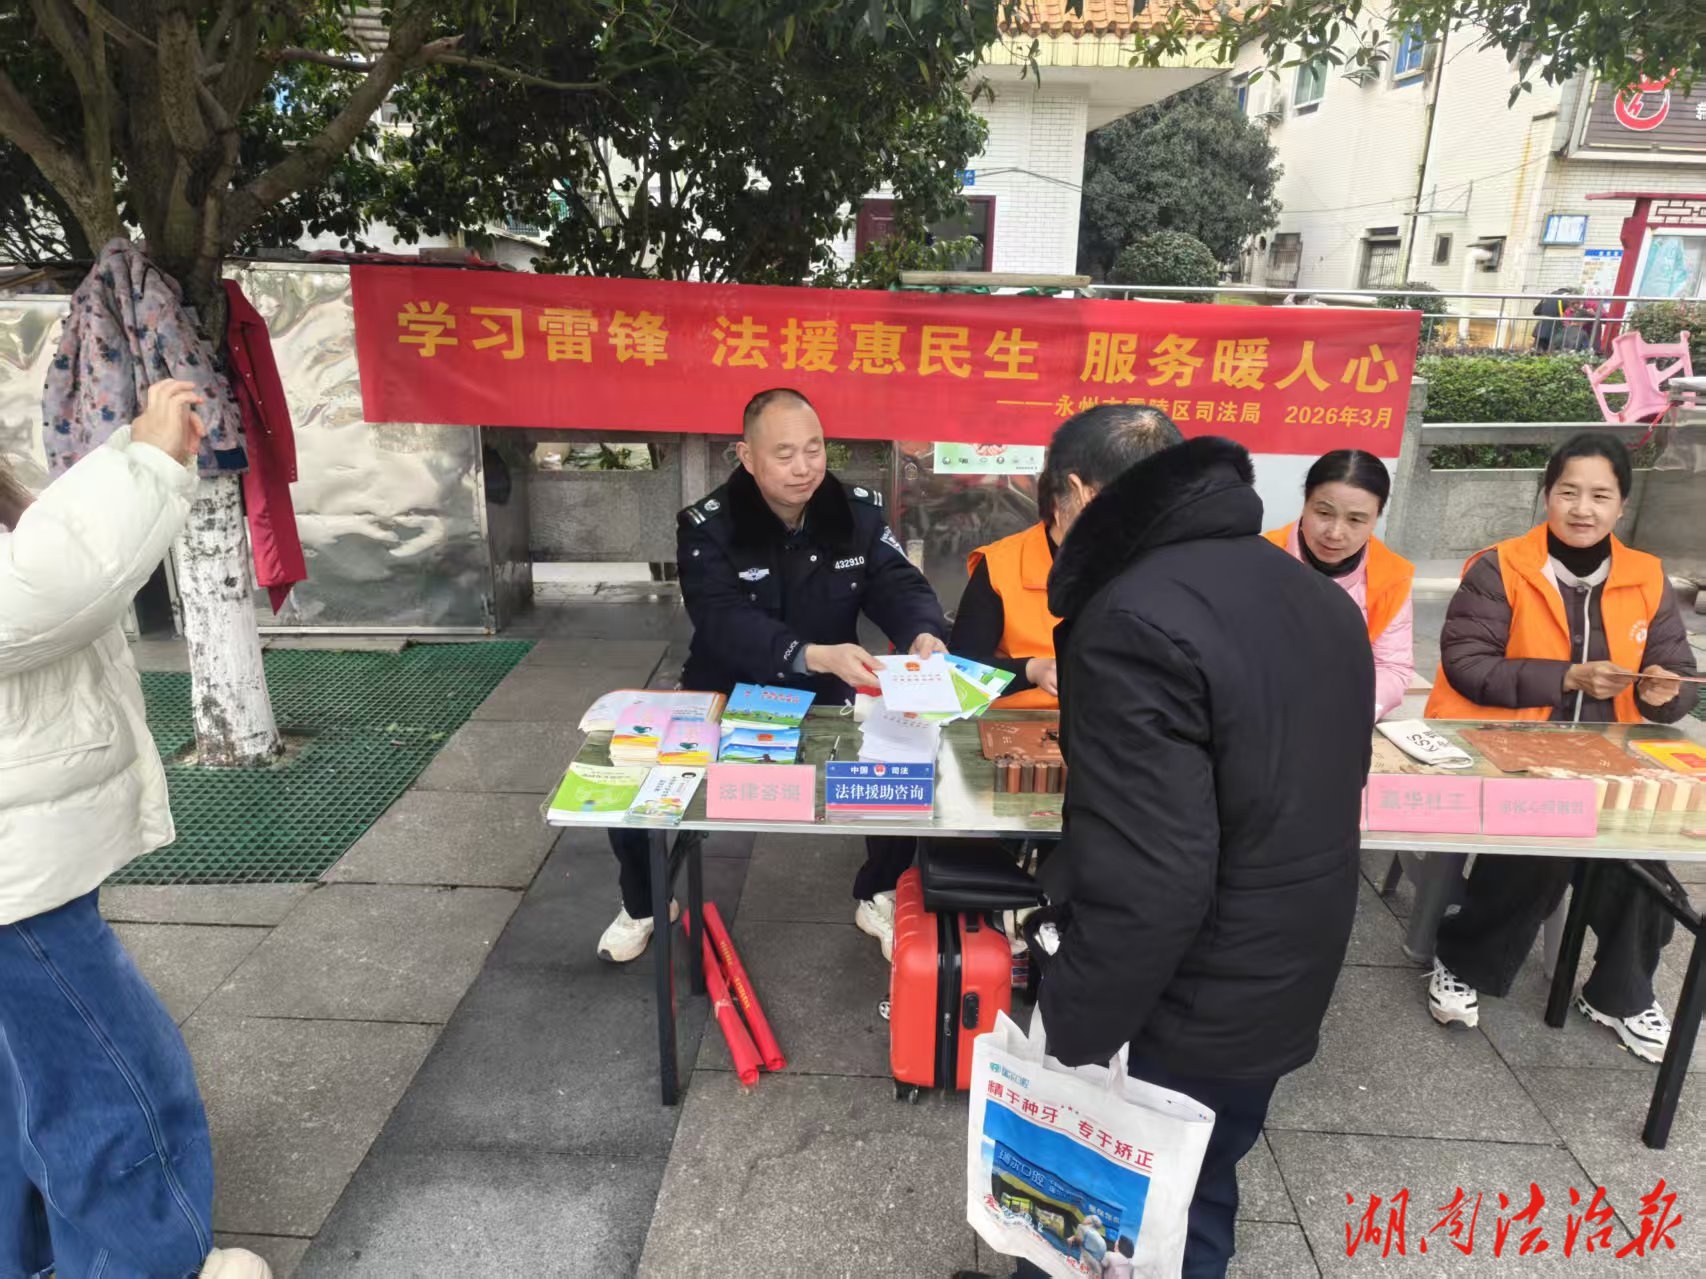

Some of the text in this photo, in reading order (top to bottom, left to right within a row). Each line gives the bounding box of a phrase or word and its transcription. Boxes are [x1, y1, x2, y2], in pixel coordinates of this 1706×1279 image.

[398, 302, 1400, 395] 学习雷锋 法援惠民生 服务暖人心
[1284, 405, 1393, 429] 2026年3月
[834, 556, 866, 570] 432910
[850, 765, 909, 776] 中国 司法
[834, 783, 925, 802] 法律援助咨询
[987, 1079, 1155, 1169] 精于种牙 专于矫正
